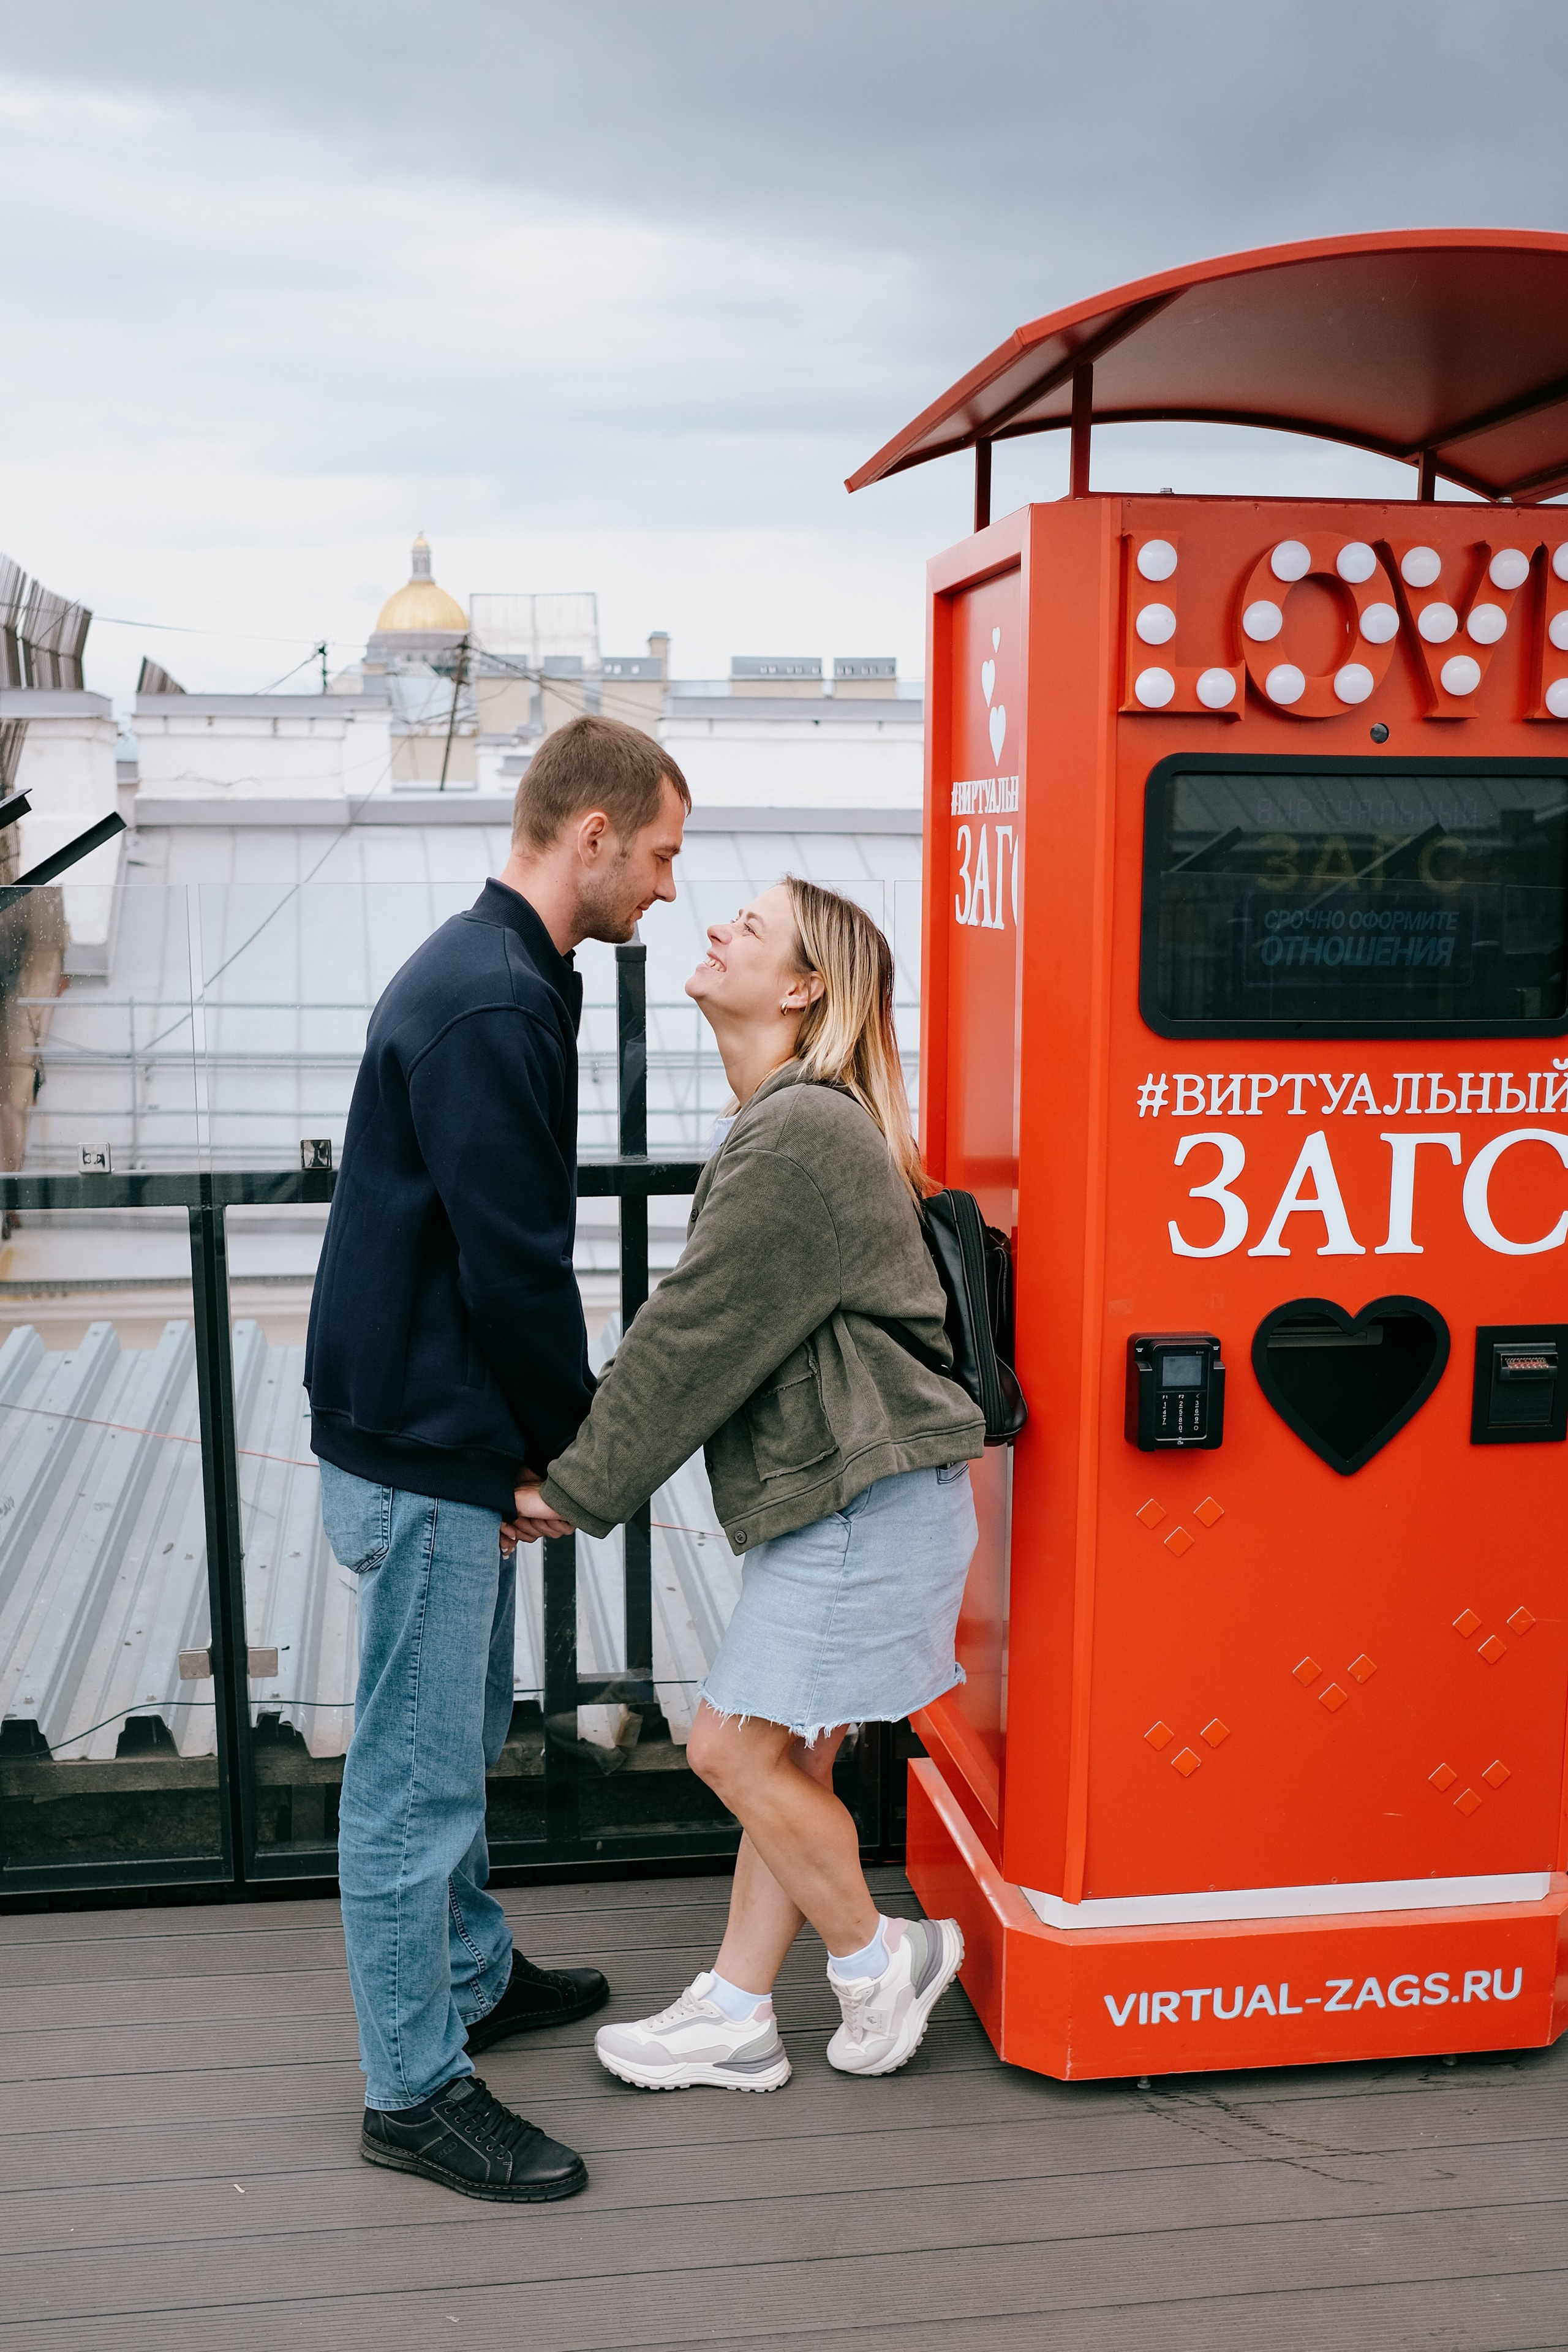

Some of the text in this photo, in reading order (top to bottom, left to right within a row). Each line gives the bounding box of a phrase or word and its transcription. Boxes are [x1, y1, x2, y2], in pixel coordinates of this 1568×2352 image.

[1257, 833, 1468, 892] ЗАГС
[1264, 910, 1460, 930] СРОЧНО ОФОРМИТЕ
[1261, 935, 1455, 966] ОТНОШЕНИЯ
[1137, 1058, 1568, 1118] #ВИРТУАЛЬНЫЙ
[1168, 1128, 1568, 1258] ЗАГС
[1103, 1967, 1523, 2026] VIRTUAL-ZAGS.RU
